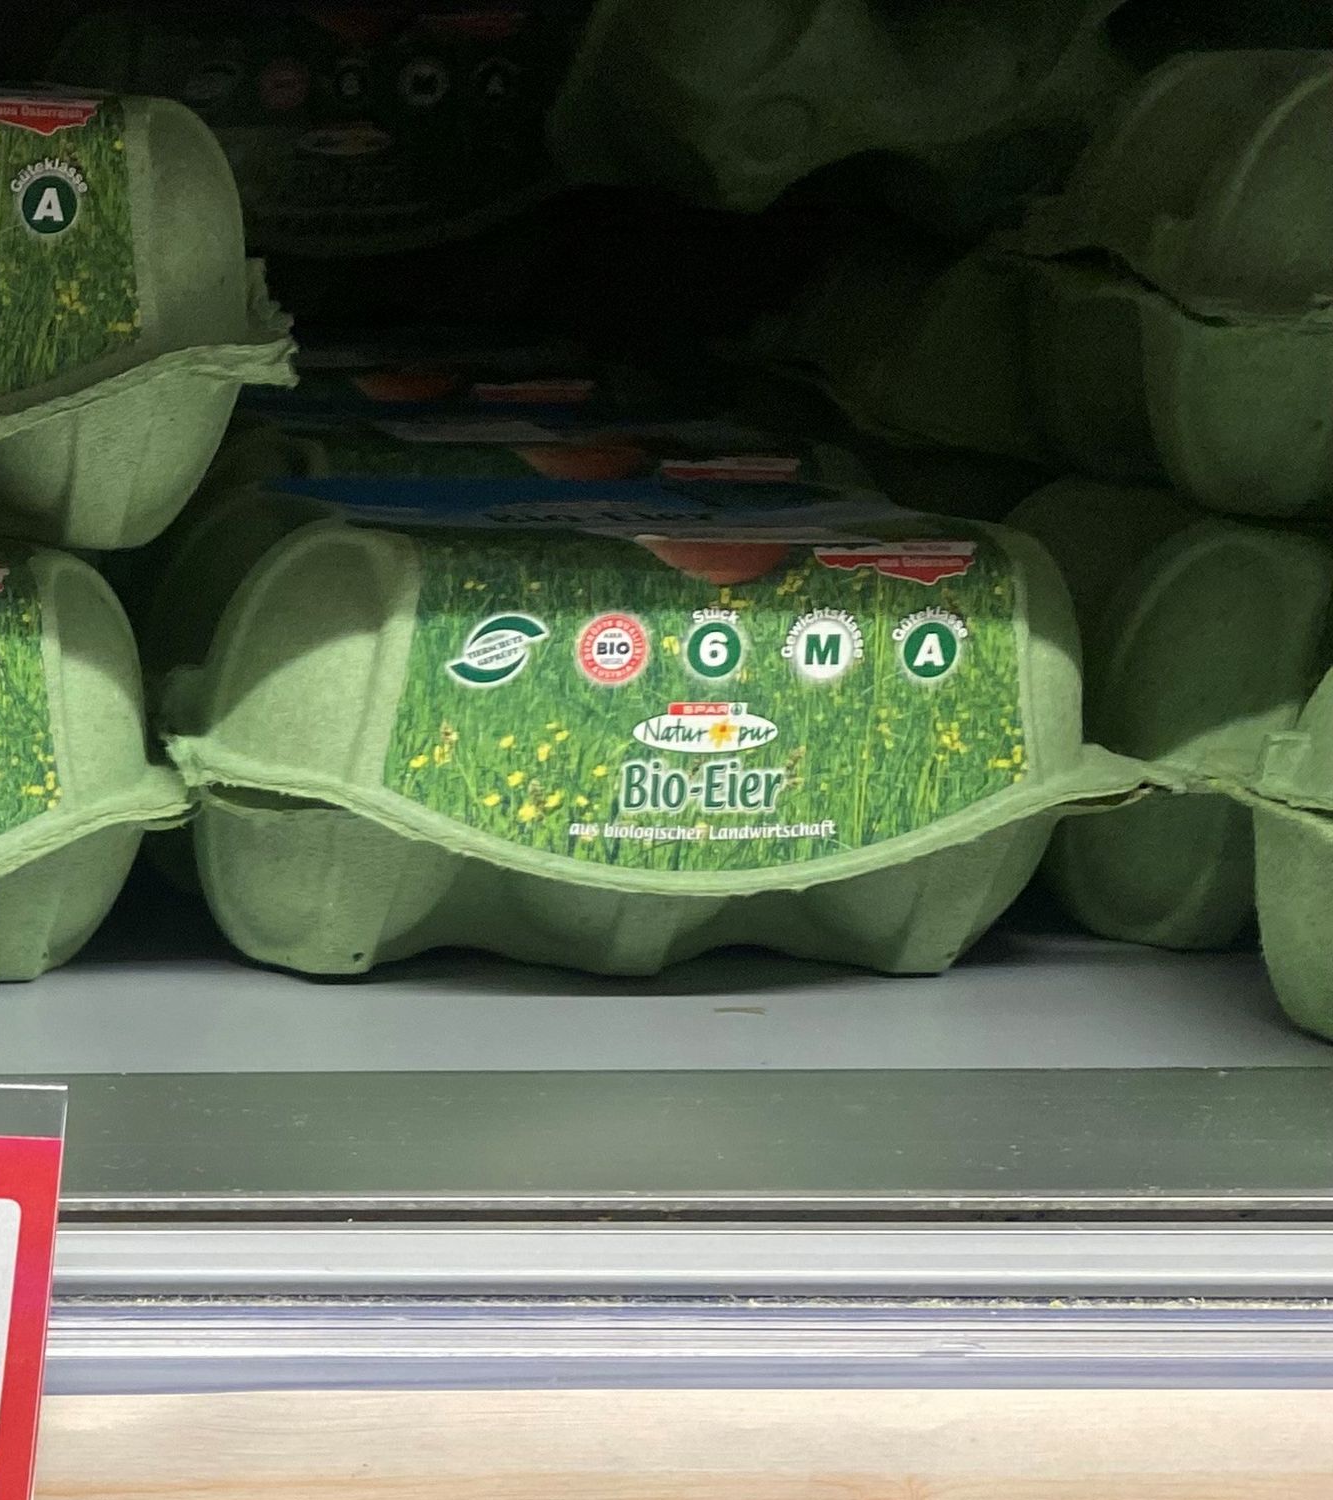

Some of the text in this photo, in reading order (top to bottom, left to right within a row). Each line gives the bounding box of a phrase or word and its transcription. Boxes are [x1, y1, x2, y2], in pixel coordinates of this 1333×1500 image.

[33, 187, 65, 221] A
[700, 635, 728, 667] 6
[804, 634, 841, 667] M
[914, 634, 945, 666] A
[642, 718, 776, 748] Natur pur
[624, 761, 783, 811] Bio-Eier
[604, 819, 836, 842] biologischer Landwirtschaft
